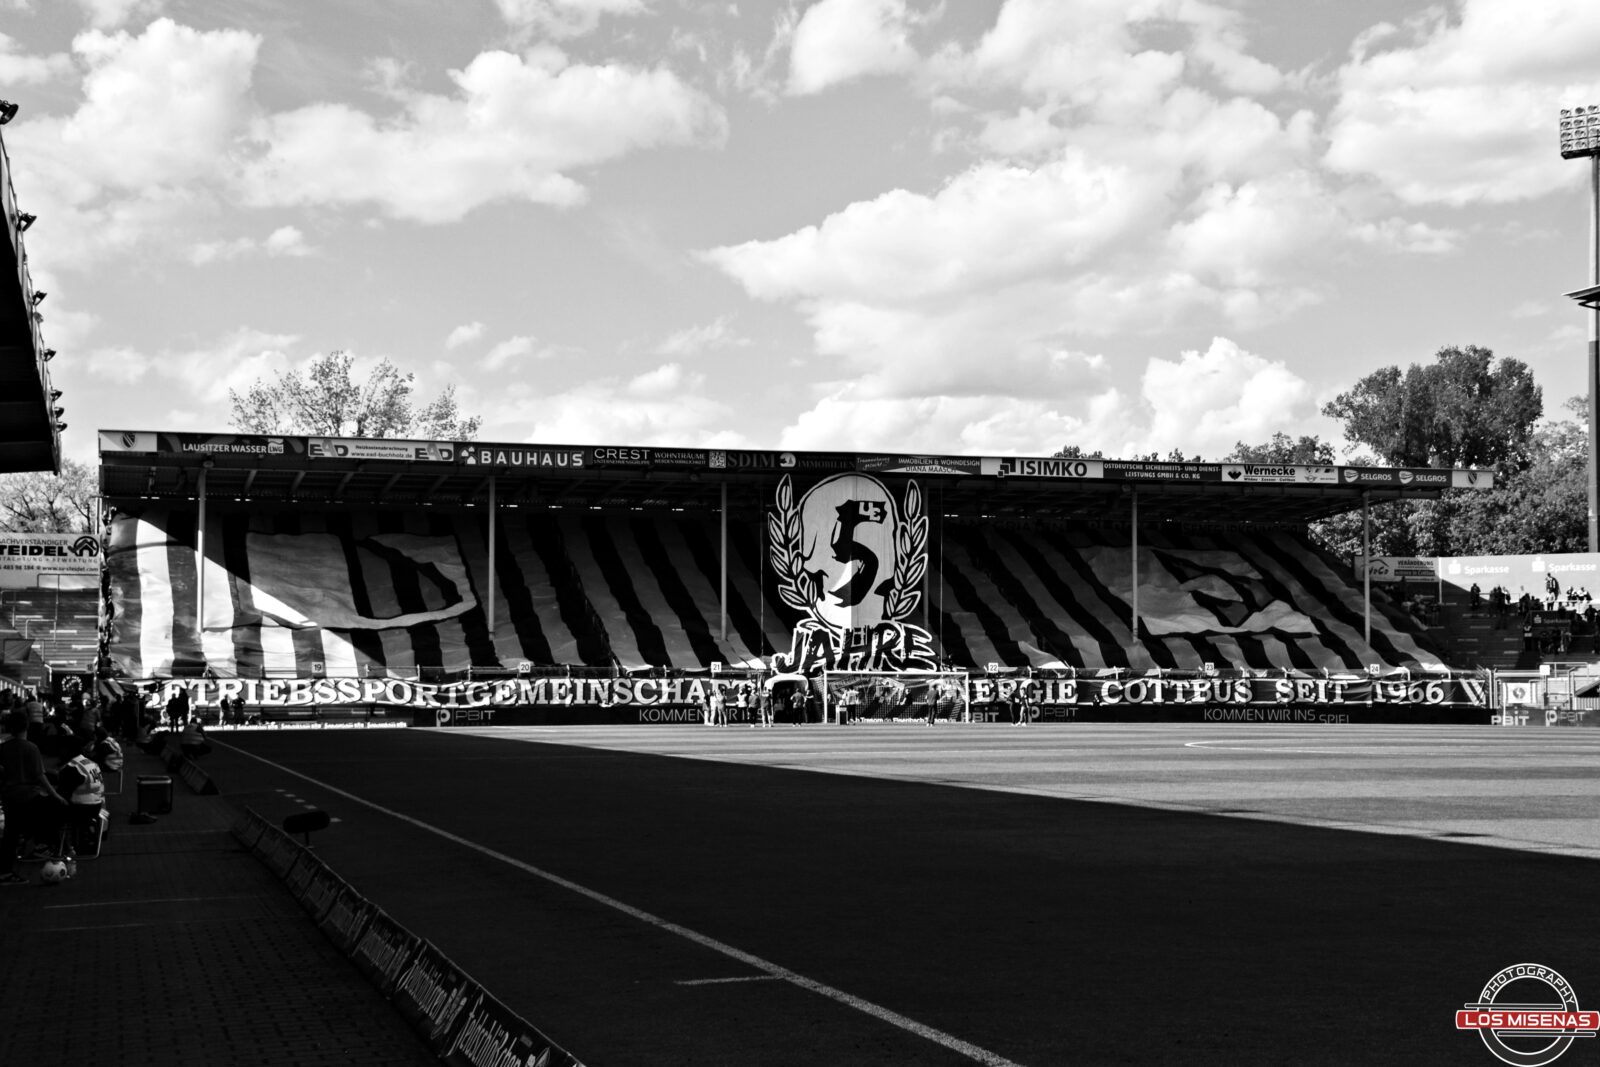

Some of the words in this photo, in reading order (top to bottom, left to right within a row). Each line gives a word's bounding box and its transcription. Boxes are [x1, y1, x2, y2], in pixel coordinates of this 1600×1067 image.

[183, 443, 230, 452] LAUSITZER
[231, 445, 267, 453] WASSER
[309, 440, 349, 457] EAD
[415, 444, 453, 460] EAD
[481, 450, 583, 467] BAUHAUS
[594, 448, 651, 460] CREST
[898, 457, 933, 466] IMMOBILIEN
[941, 459, 980, 468] WOHNDESIGN
[1105, 463, 1142, 471] OSTDEUTSCHE
[1145, 464, 1183, 472] SICHERHEITS-
[1020, 461, 1087, 477] ISIMKO
[1244, 465, 1296, 476] Wernecke
[1125, 471, 1155, 479] LEISTUNGS
[1361, 472, 1392, 481] SELGROS
[1416, 474, 1447, 483] SELGROS
[1464, 566, 1510, 576] Sparkasse
[1548, 563, 1597, 574] Sparkasse
[772, 618, 937, 675] JAHRE
[927, 679, 1078, 704] NERGIE
[1101, 679, 1253, 704] COTTBUS
[1275, 679, 1349, 703] SEIT
[1372, 681, 1445, 704] 1966
[456, 710, 496, 720] PBIT
[638, 709, 705, 722] KOMMEN
[1044, 707, 1079, 718] PBIT
[1204, 709, 1264, 721] KOMMEN
[1267, 709, 1291, 721] WIR
[1294, 709, 1316, 721] INS
